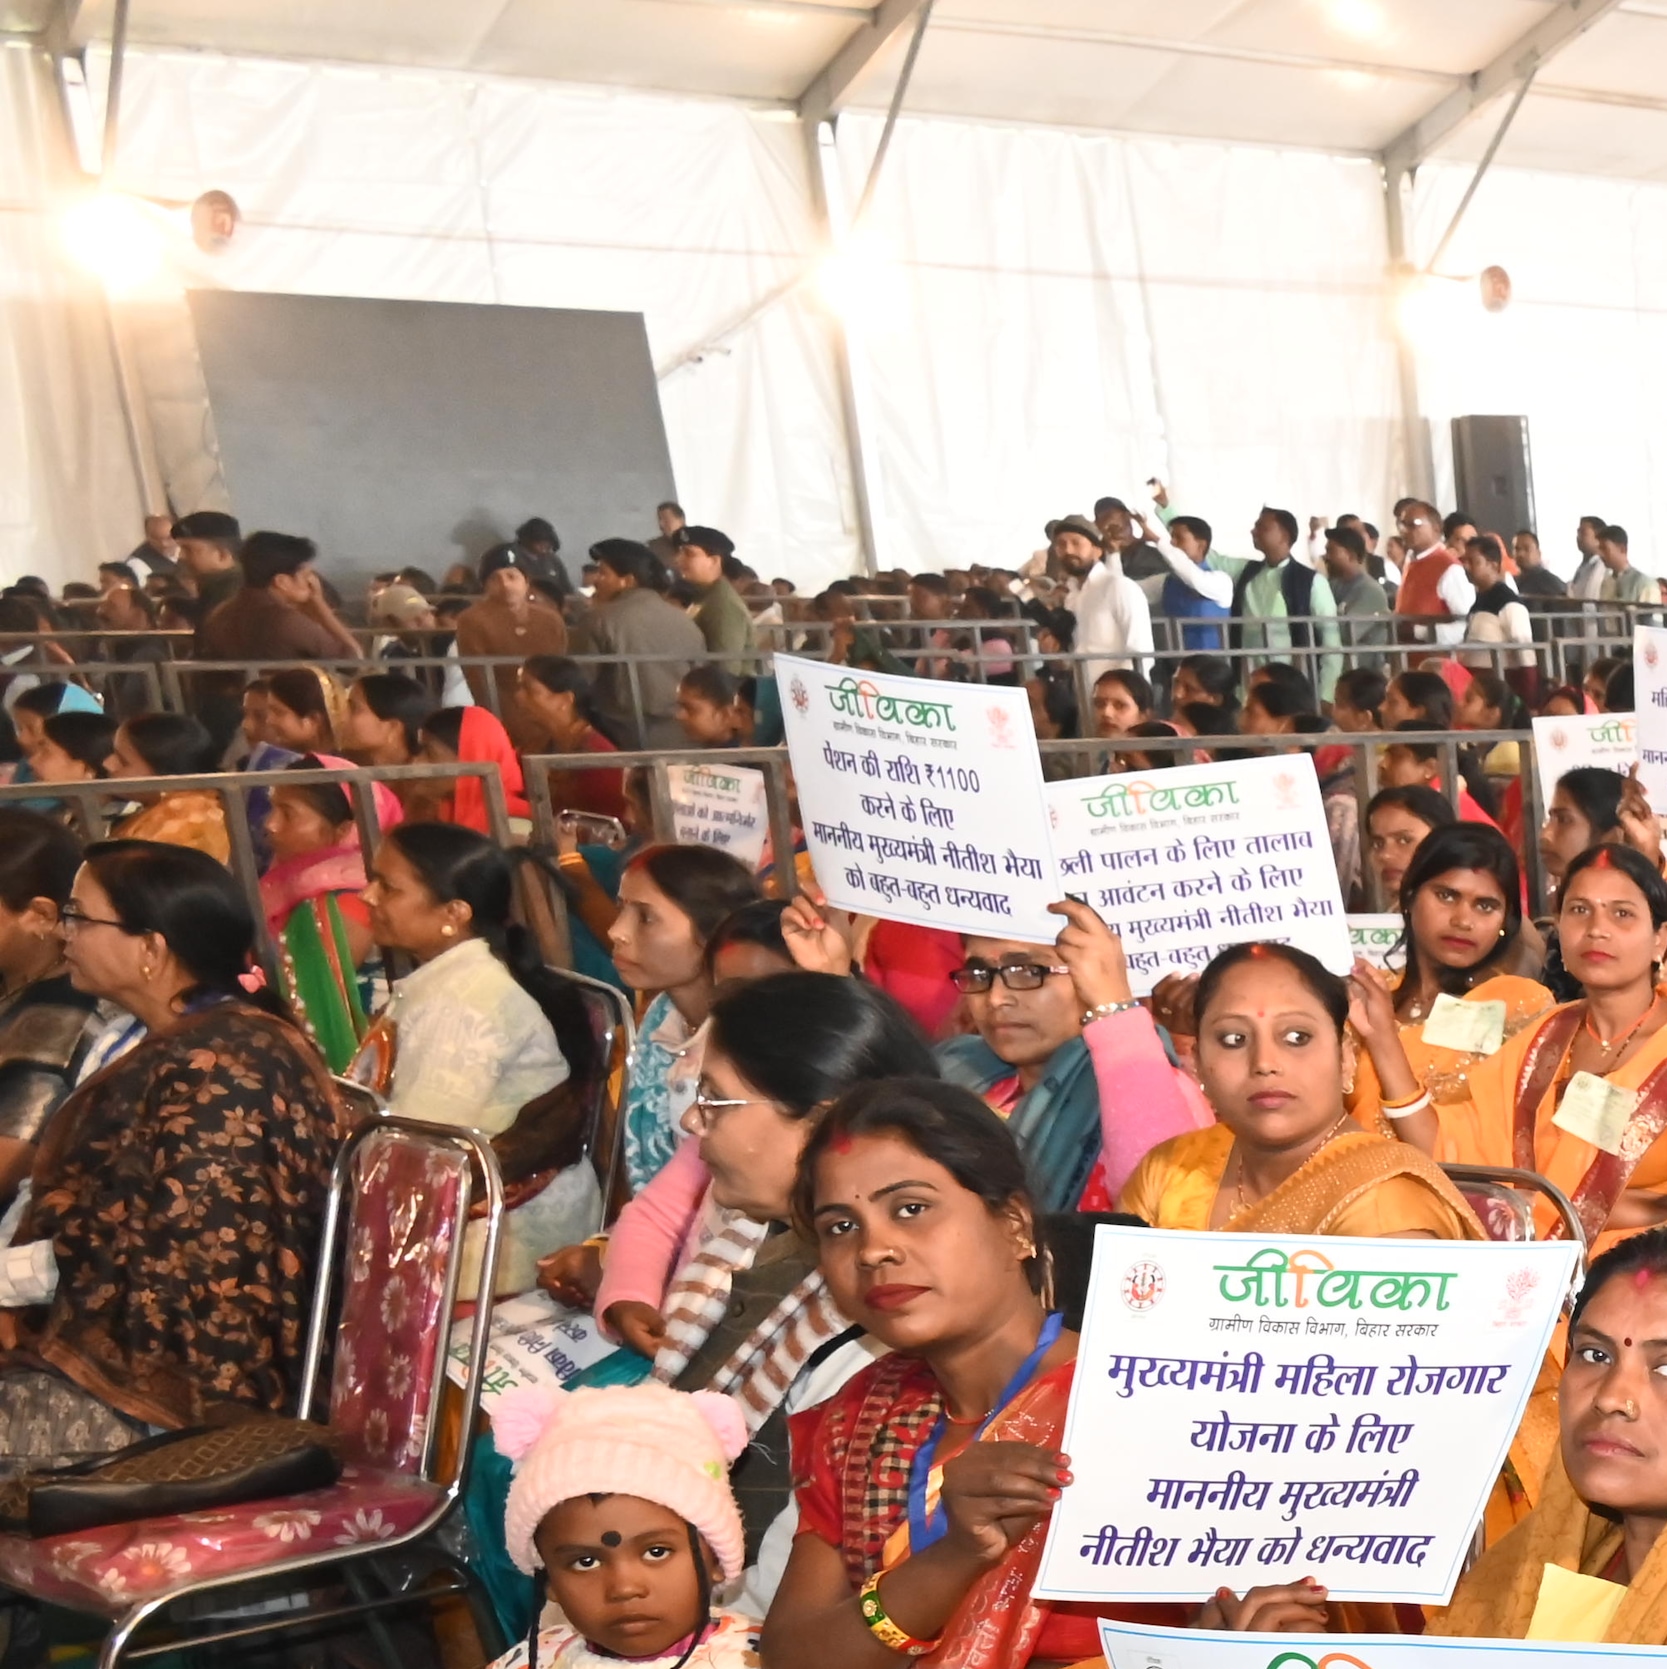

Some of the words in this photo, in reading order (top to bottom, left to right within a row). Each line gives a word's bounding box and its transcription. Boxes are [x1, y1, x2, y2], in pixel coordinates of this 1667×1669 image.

[825, 679, 957, 732] जीविका
[860, 747, 882, 780] की
[885, 755, 921, 786] राशि
[925, 763, 981, 794] ₹1100
[858, 791, 897, 821] करने
[898, 794, 917, 824] के
[919, 797, 955, 831] लिए
[1081, 781, 1239, 818] जीविका
[812, 821, 865, 853] माननीय
[866, 833, 938, 866] मुख्यमंत्री
[939, 840, 997, 875] नीतीश
[1001, 848, 1043, 880] भैया
[1099, 847, 1159, 871] पालन
[1165, 838, 1187, 863] के
[1192, 835, 1236, 861] लिए
[1245, 831, 1313, 855] तालाब
[1098, 879, 1166, 908] आवंटन
[1172, 870, 1223, 899] करने
[1230, 867, 1252, 892] के
[1259, 864, 1303, 890] लिए
[1213, 1248, 1459, 1311] जीविका
[1209, 1313, 1254, 1333] ग्रामीण
[1258, 1314, 1301, 1335] विकास
[1305, 1316, 1348, 1338] विभाग,
[1355, 1317, 1392, 1338] बिहार
[1395, 1323, 1440, 1337] सरकार
[1108, 1350, 1266, 1398] मुख्यमंत्री
[1274, 1353, 1380, 1397] महिला
[1386, 1354, 1513, 1396] रोजगार
[1190, 1409, 1299, 1454] योजना
[1305, 1412, 1341, 1454] के
[1345, 1413, 1415, 1454] लिए
[1146, 1469, 1274, 1511] माननीय
[1278, 1468, 1420, 1521] मुख्यमंत्री
[1079, 1524, 1182, 1567] नीतीश
[1187, 1526, 1255, 1567] भैया
[1256, 1526, 1304, 1566] को
[1305, 1534, 1436, 1568] धन्यवाद
